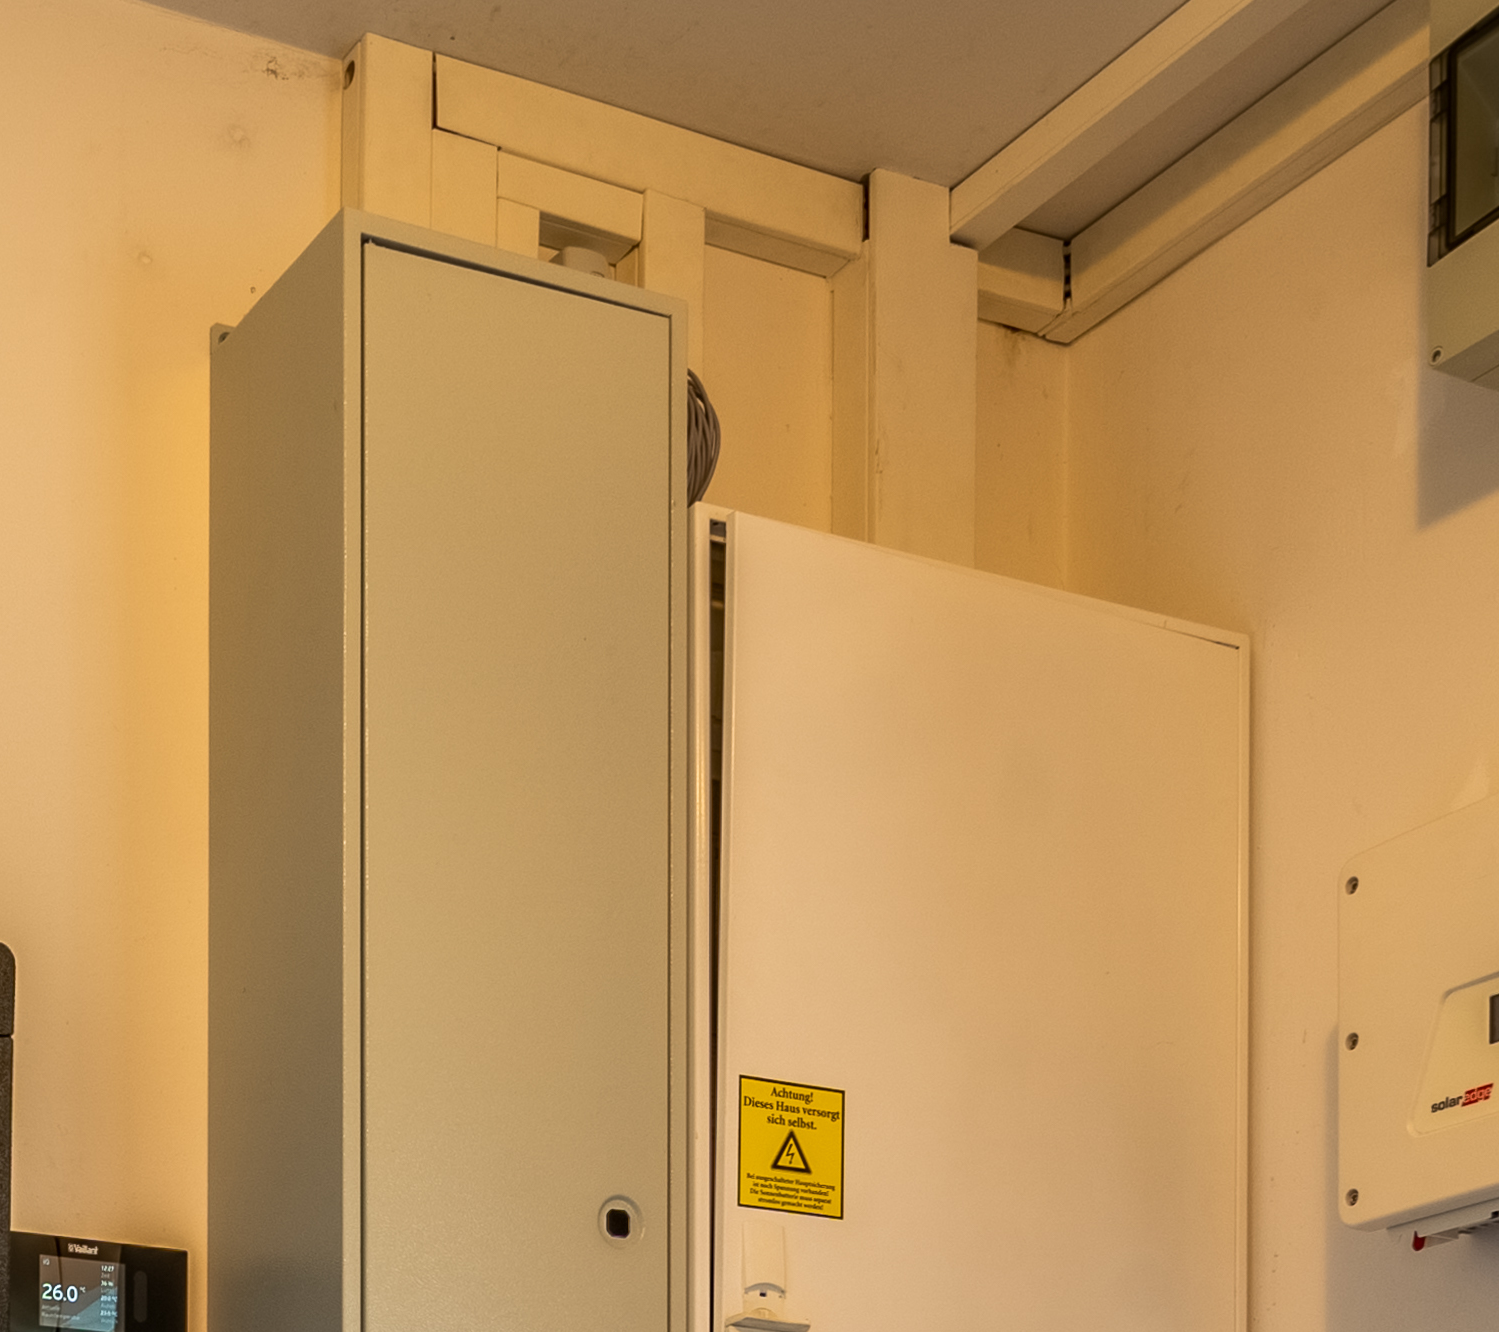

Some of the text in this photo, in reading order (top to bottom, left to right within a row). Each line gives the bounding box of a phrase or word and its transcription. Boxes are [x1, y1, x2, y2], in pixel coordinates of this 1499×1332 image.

[770, 1087, 814, 1105] Achtung!
[1430, 1083, 1494, 1114] solaredge
[743, 1096, 840, 1122] Dieses Haus versorgt
[767, 1114, 817, 1130] sich selbst.
[41, 1283, 79, 1302] 26.0
